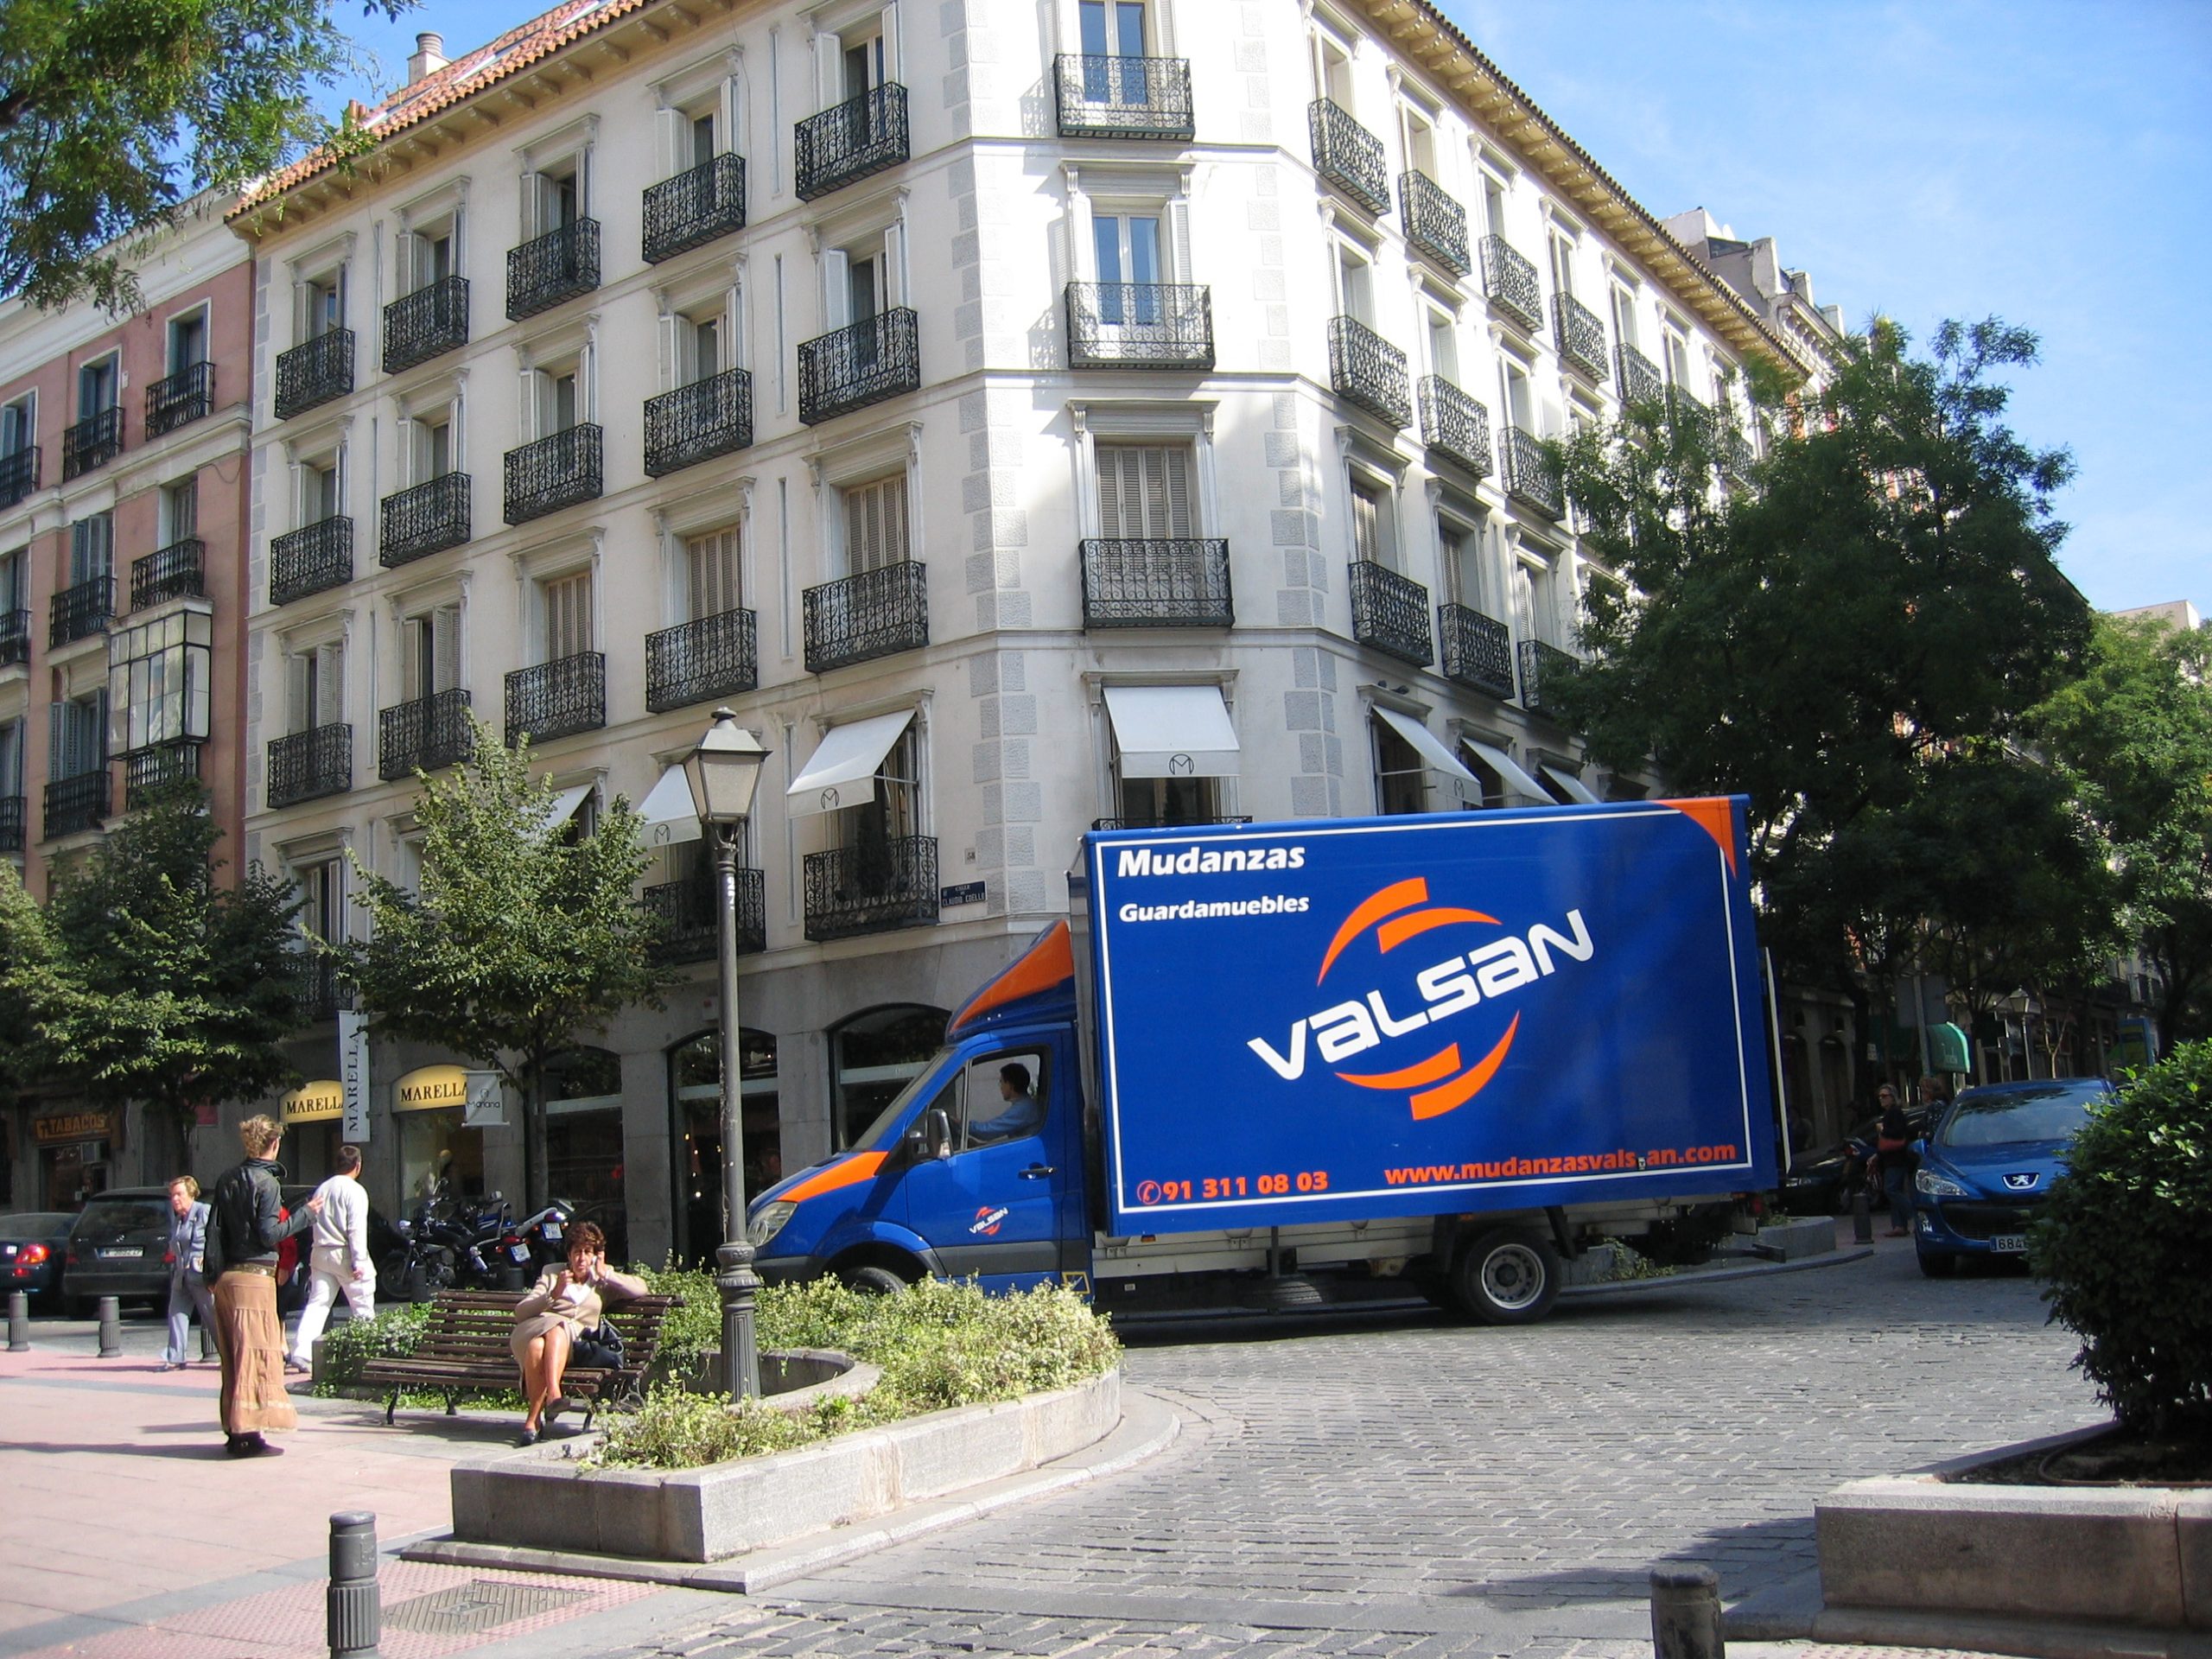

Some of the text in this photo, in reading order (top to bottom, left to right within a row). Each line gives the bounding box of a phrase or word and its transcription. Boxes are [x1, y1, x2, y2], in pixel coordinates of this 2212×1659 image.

[1117, 846, 1306, 878] Mudanzas
[965, 892, 984, 903] COELLO
[1119, 894, 1310, 923] Guardamuebles
[348, 1032, 360, 1132] MARELLA
[286, 1096, 344, 1115] MARELL
[49, 1113, 106, 1135] TABACOS
[1163, 1171, 1328, 1202] 91 311 08 03
